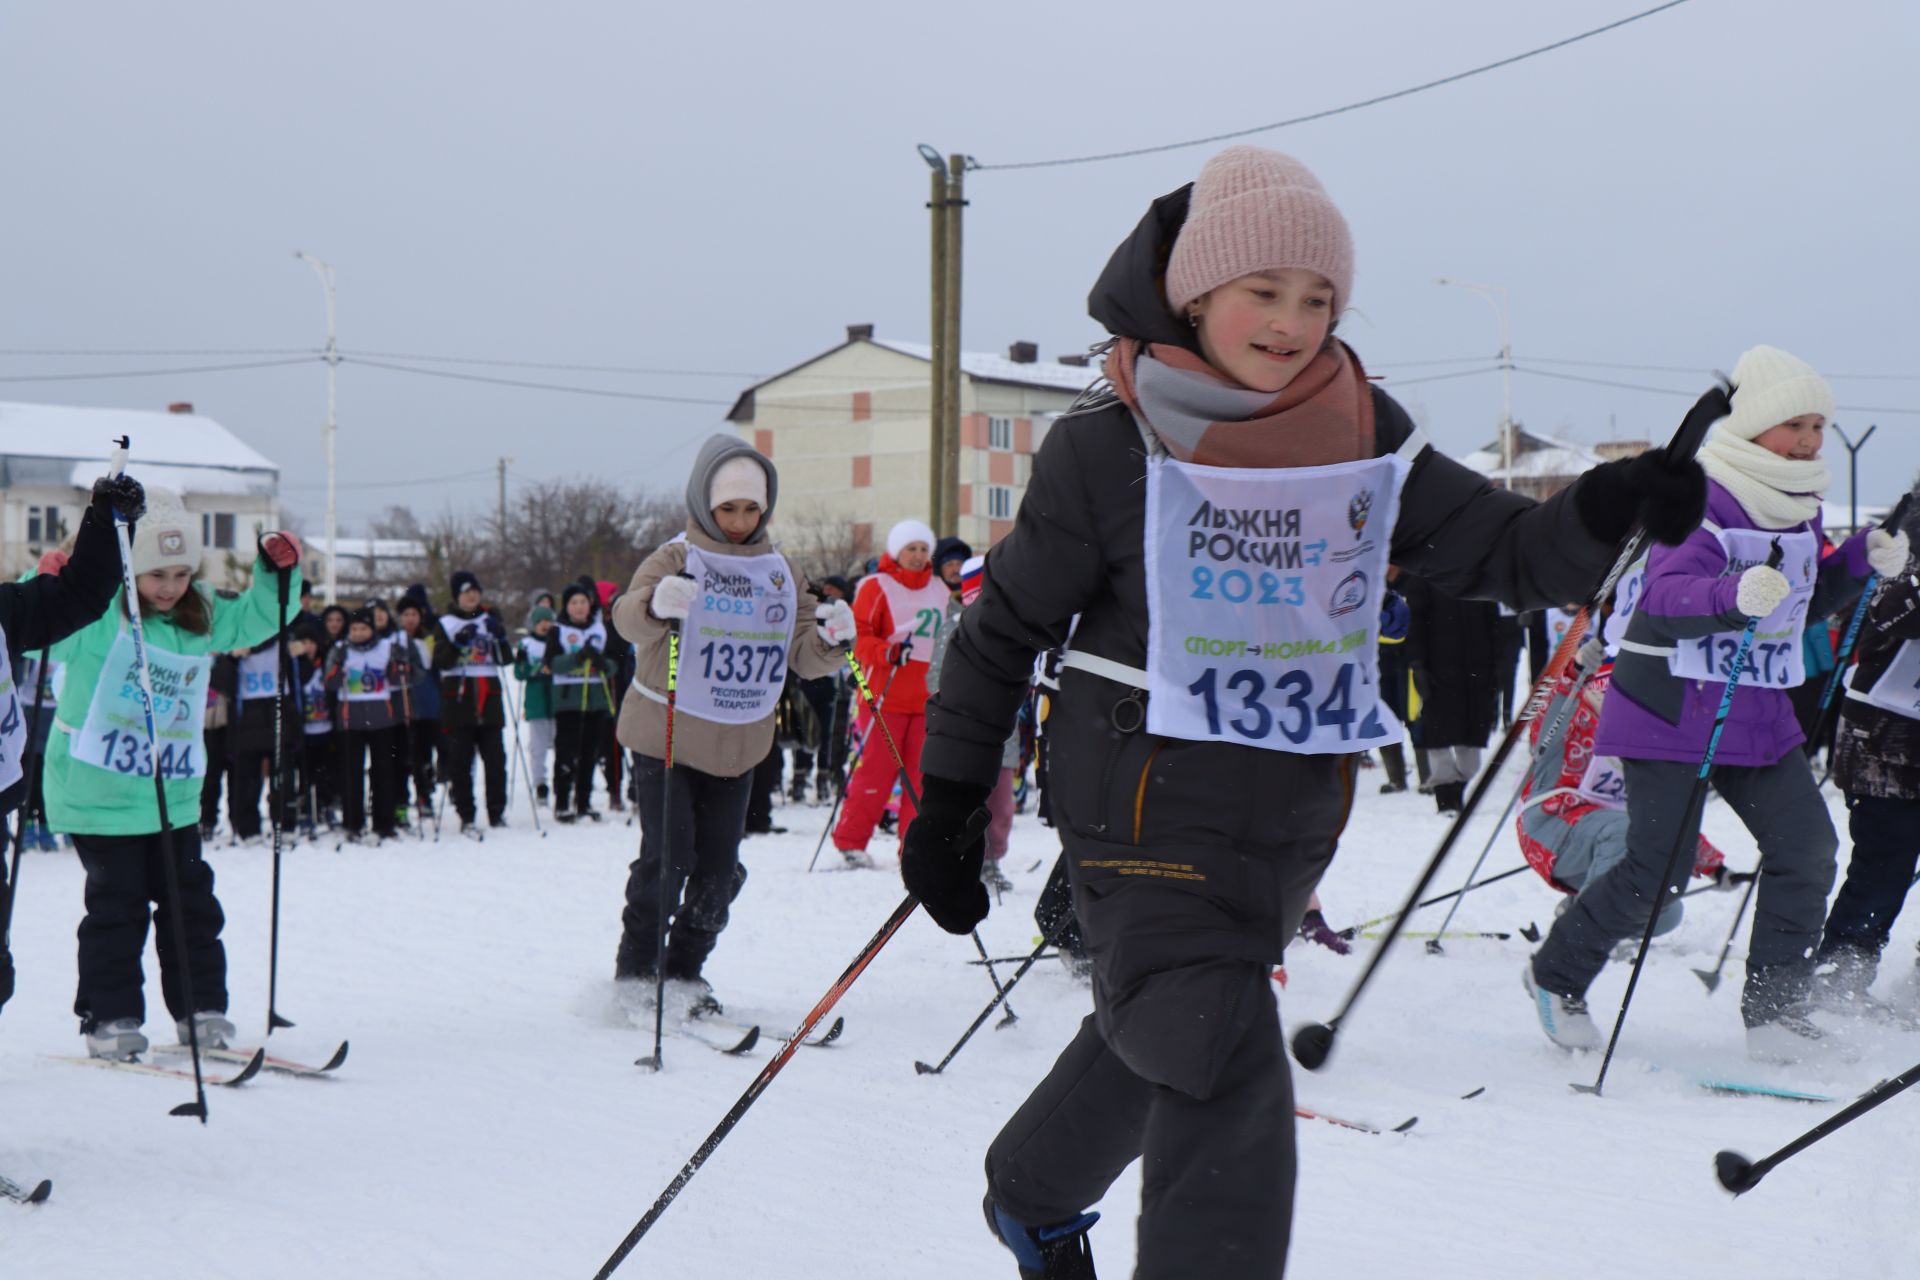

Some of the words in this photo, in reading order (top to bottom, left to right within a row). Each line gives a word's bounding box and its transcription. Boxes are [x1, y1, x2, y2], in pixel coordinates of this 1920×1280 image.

[1189, 531, 1303, 569] РОССИИ
[704, 595, 754, 616] 2023
[1190, 566, 1306, 606] 2023
[668, 634, 679, 691] SABLE
[700, 641, 785, 683] 13372
[1184, 635, 1248, 657] СПОРТ
[845, 649, 873, 702] SABLE
[1724, 638, 1750, 700] NORDWAY
